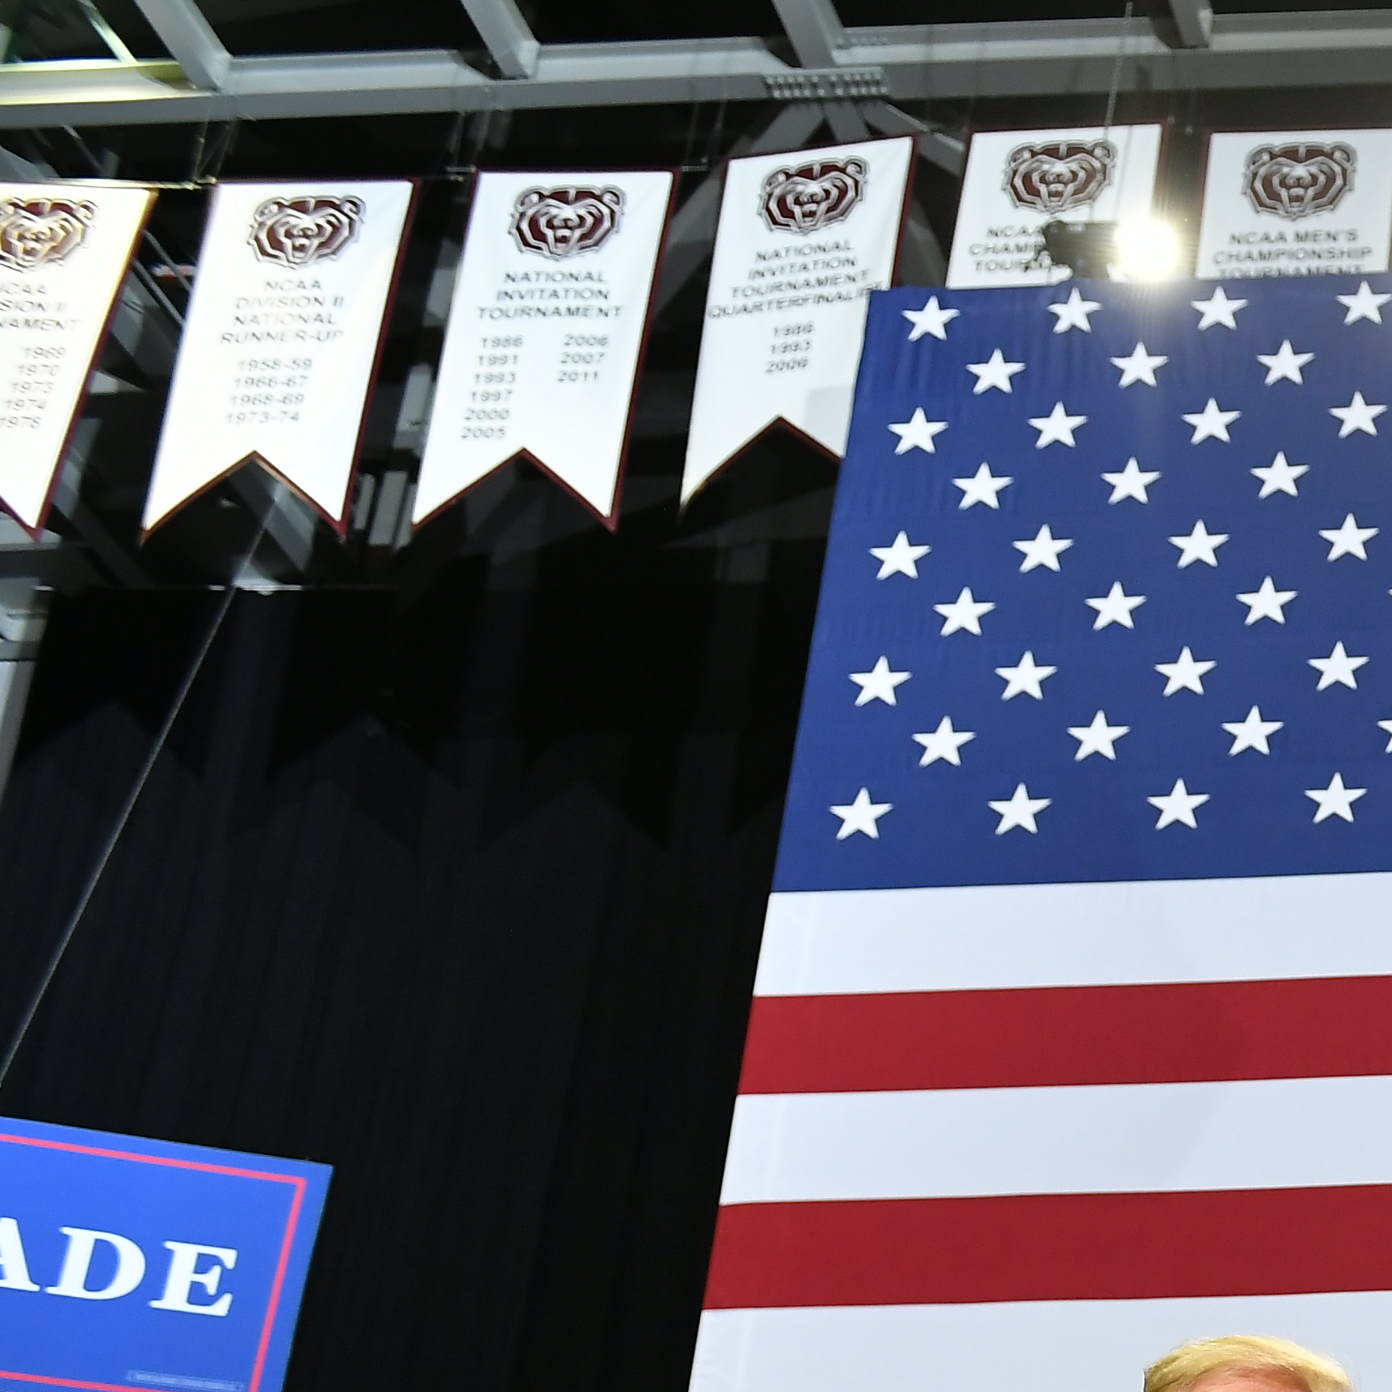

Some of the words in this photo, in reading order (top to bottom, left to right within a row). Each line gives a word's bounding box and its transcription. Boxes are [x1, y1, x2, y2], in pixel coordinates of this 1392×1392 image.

[1229, 232, 1286, 245] NCAA
[1295, 228, 1359, 243] MEN'S
[756, 241, 852, 262] NATIONAL
[1213, 247, 1373, 264] CHAMPIONSHIP
[504, 271, 606, 283] NATIONAL
[749, 257, 856, 280] INVITATION
[731, 269, 869, 297] TOURNAMENT
[497, 288, 610, 301] INVITATION
[478, 305, 624, 319] TOURNAMENT
[558, 371, 599, 383] 2011
[0, 1217, 238, 1318] ADE
